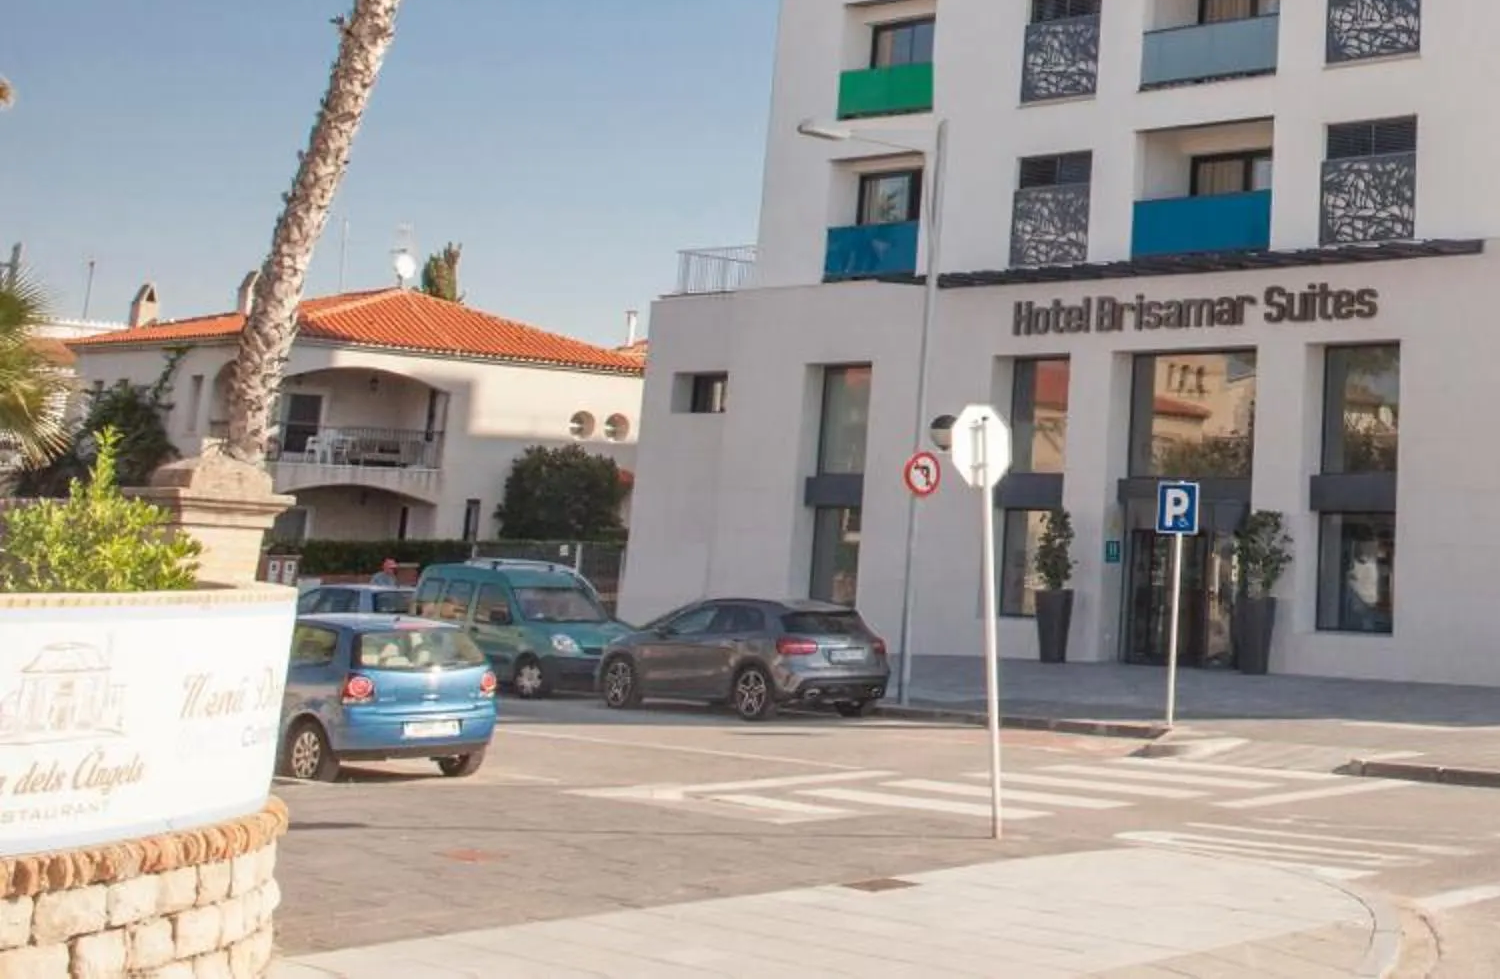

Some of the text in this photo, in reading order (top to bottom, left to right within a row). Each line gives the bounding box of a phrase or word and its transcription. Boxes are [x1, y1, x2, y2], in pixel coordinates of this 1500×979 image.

[1012, 281, 1379, 336] Hotel Brisamar Suites
[1164, 488, 1189, 528] P
[12, 760, 68, 796] dels
